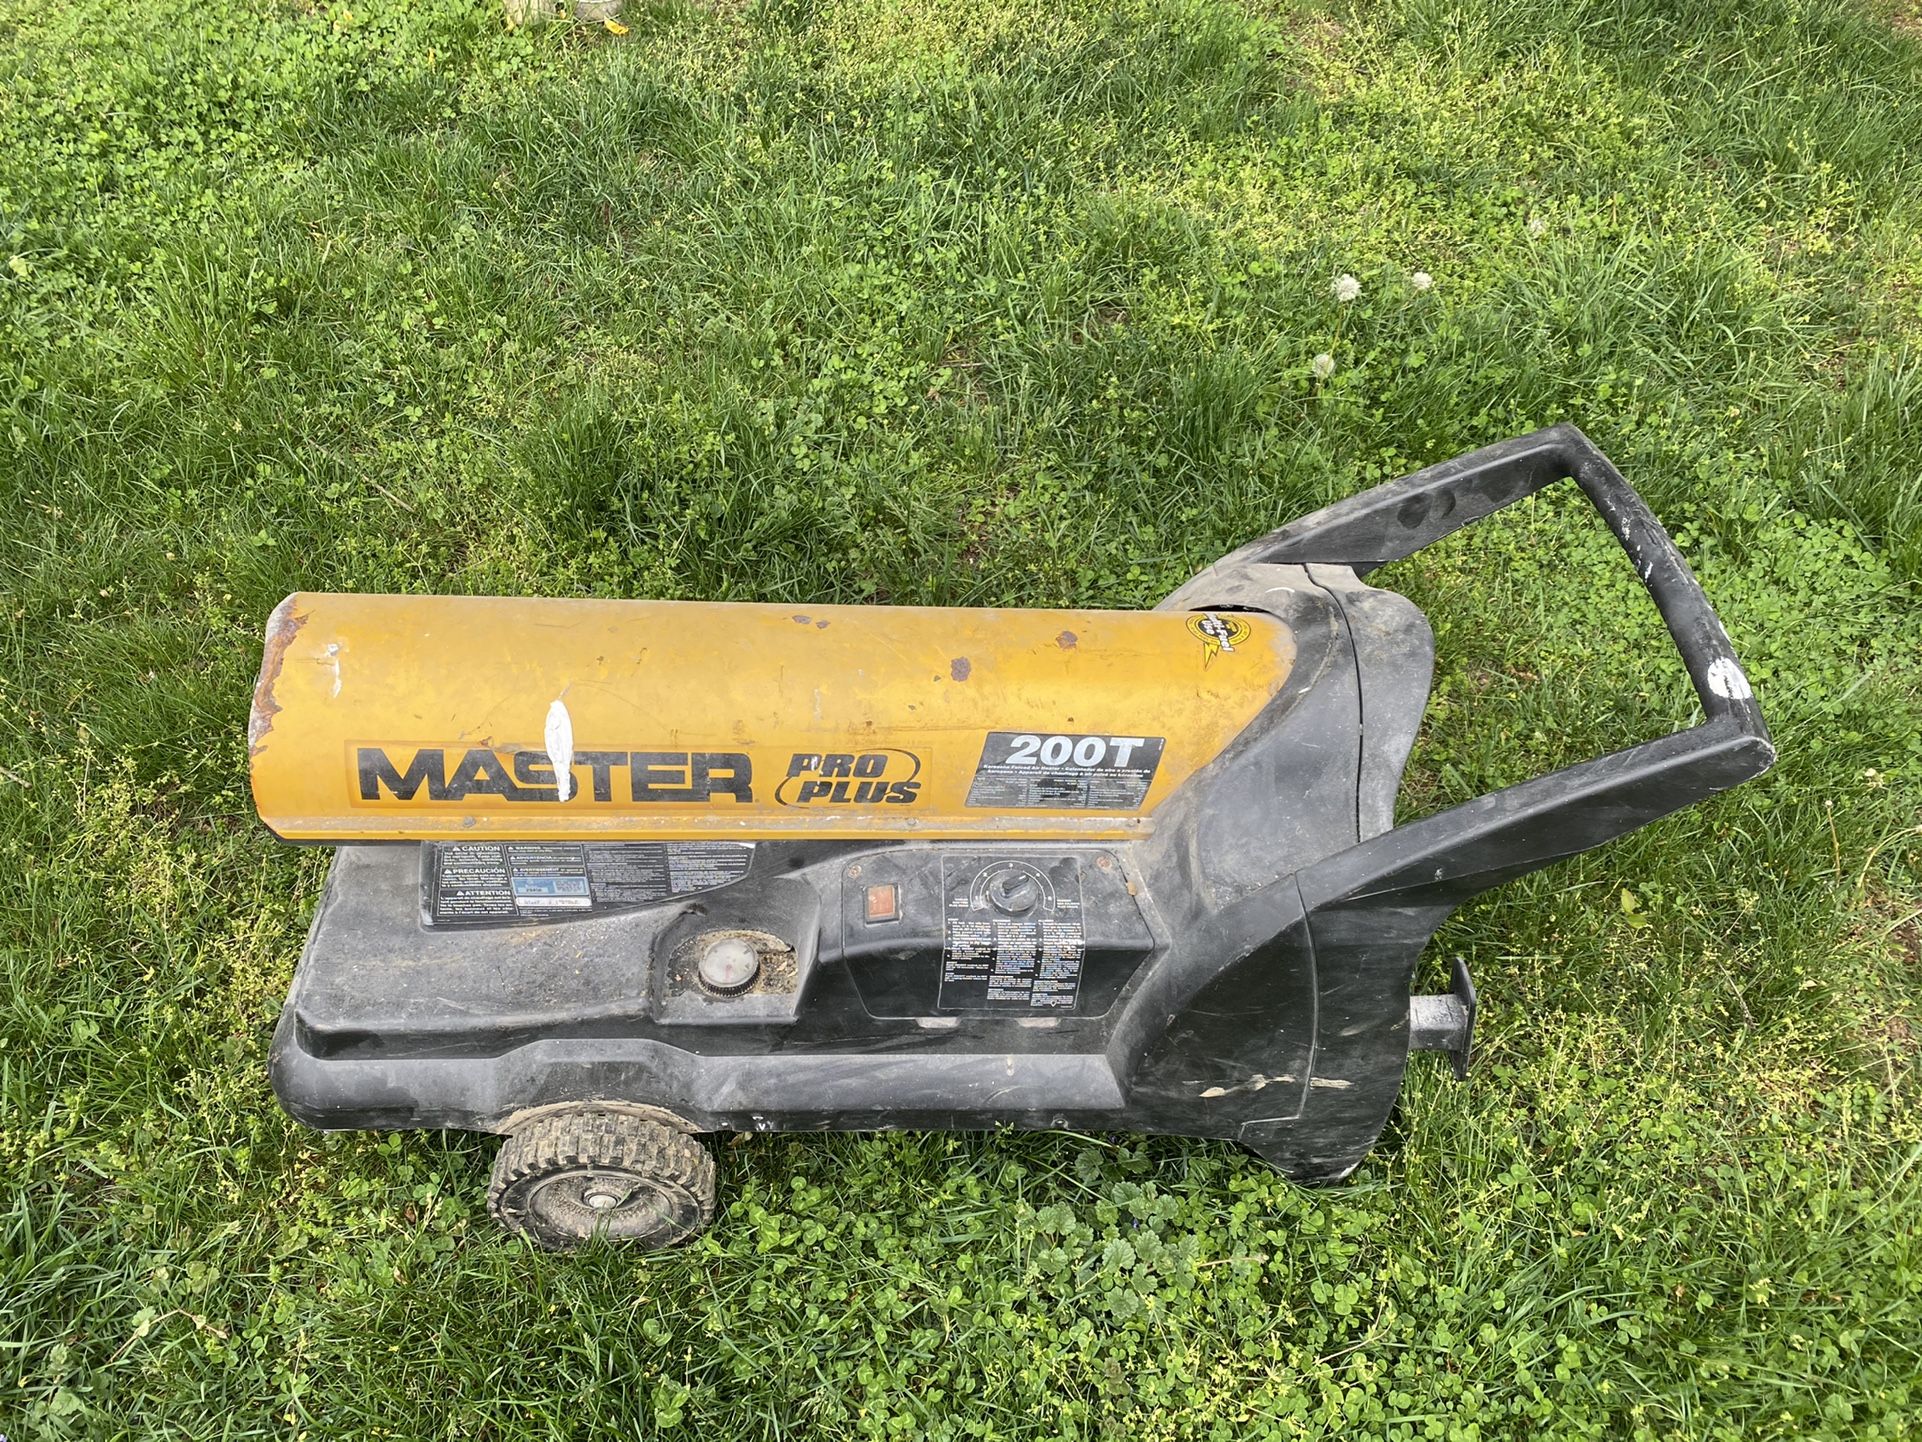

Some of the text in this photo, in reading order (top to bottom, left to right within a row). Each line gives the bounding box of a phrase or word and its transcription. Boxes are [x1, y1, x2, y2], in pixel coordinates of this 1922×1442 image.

[1005, 734, 1145, 768] 200T
[357, 748, 888, 803] MASTER PRO
[796, 780, 921, 804] PLUS
